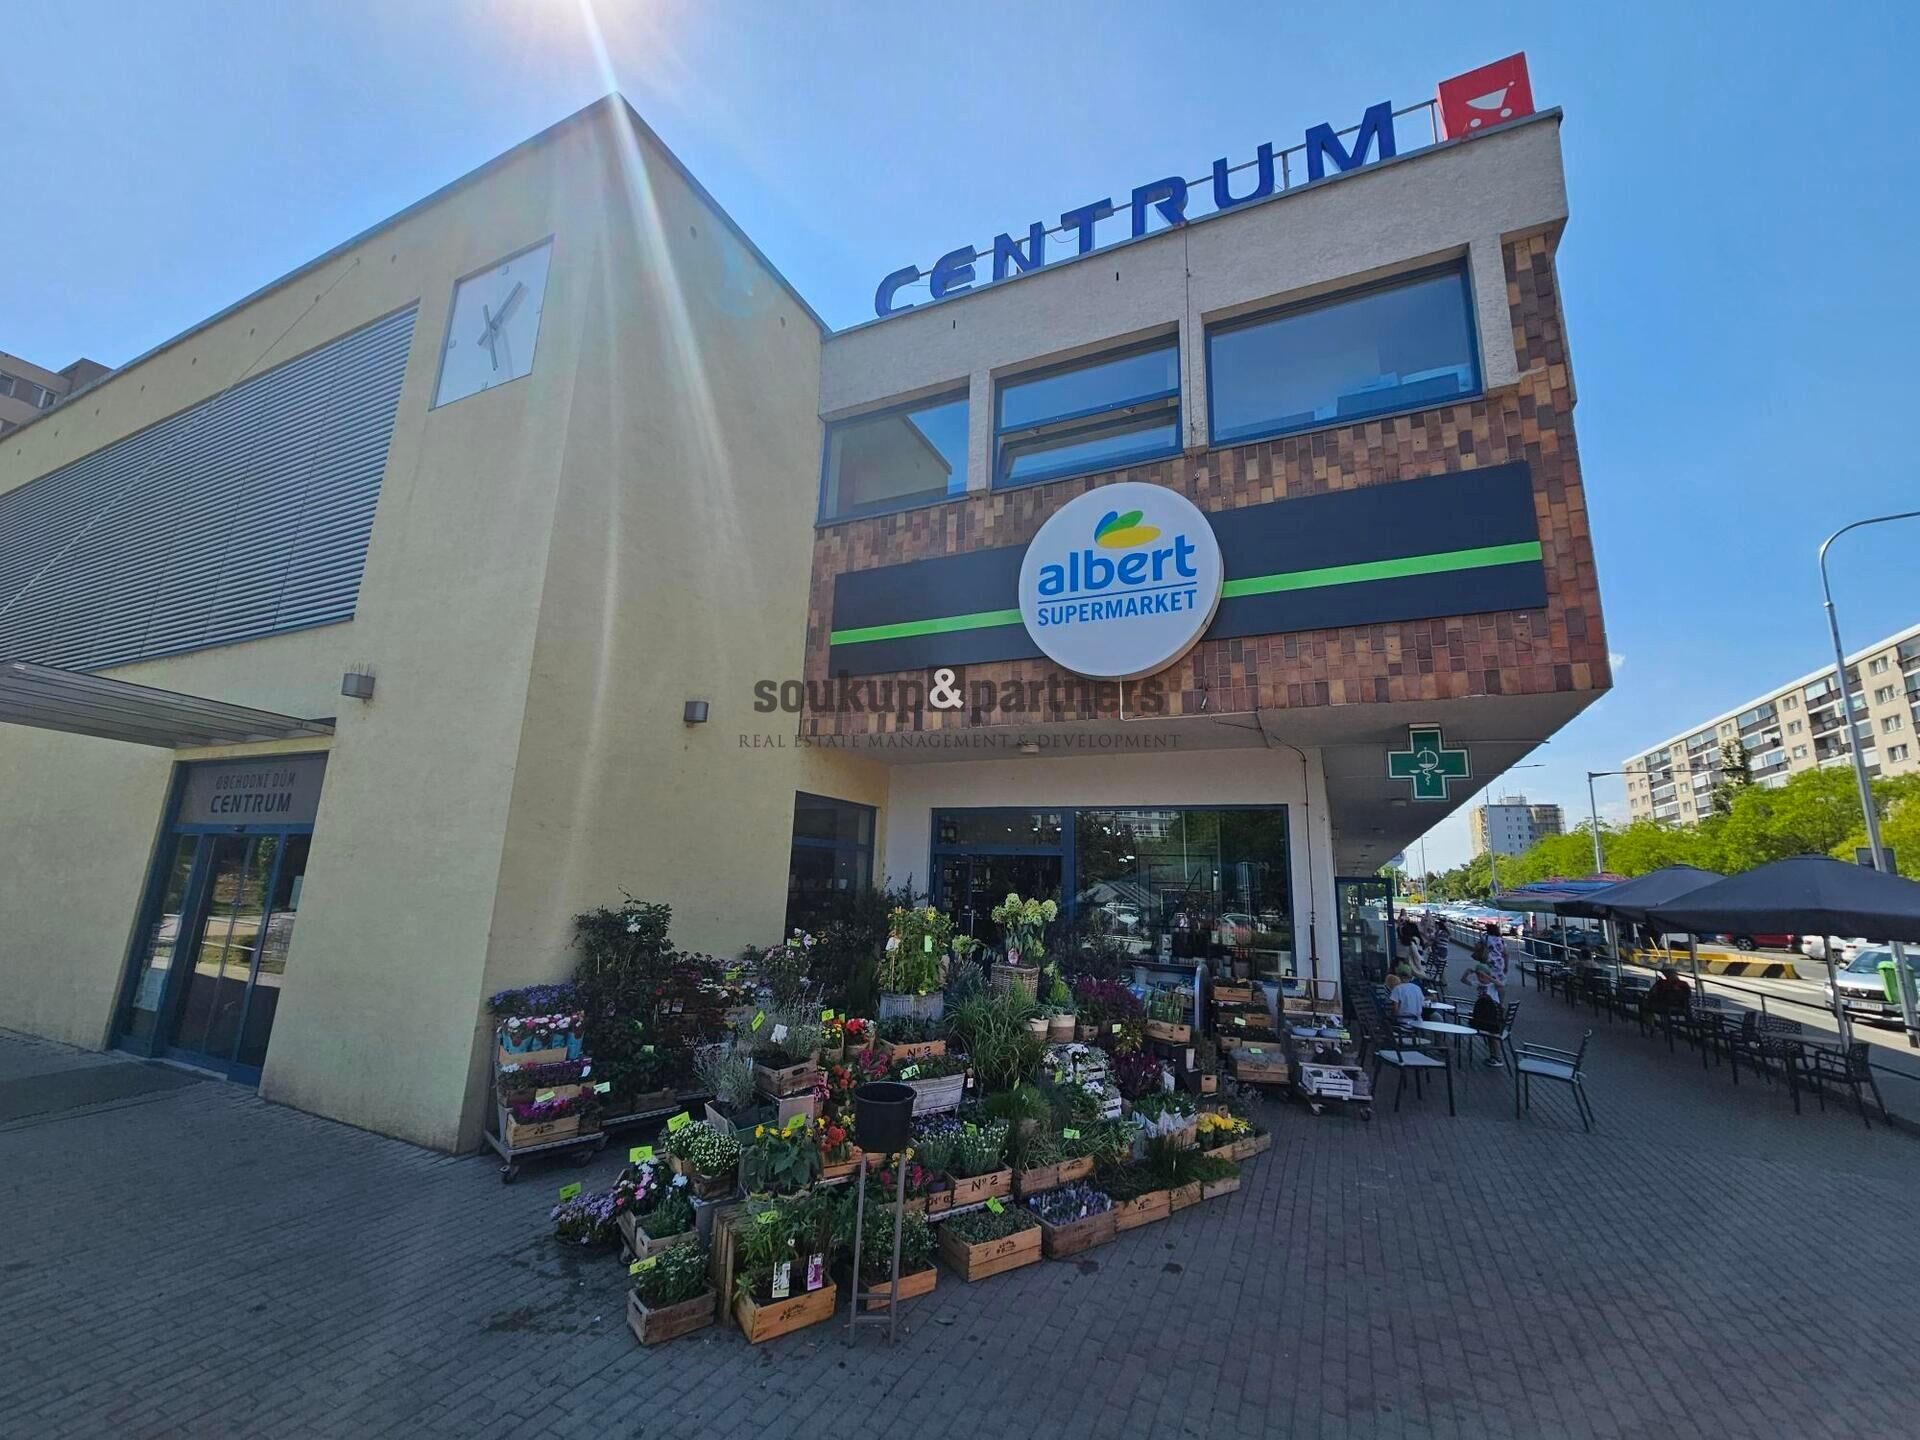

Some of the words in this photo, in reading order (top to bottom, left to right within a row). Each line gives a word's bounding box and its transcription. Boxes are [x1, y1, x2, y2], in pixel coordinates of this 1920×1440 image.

[875, 100, 1397, 318] CENTRUM
[1038, 534, 1197, 596] albert
[1038, 589, 1197, 626] SUPERMARKET
[210, 793, 292, 813] CENTRUM
[990, 1175, 998, 1185] 2
